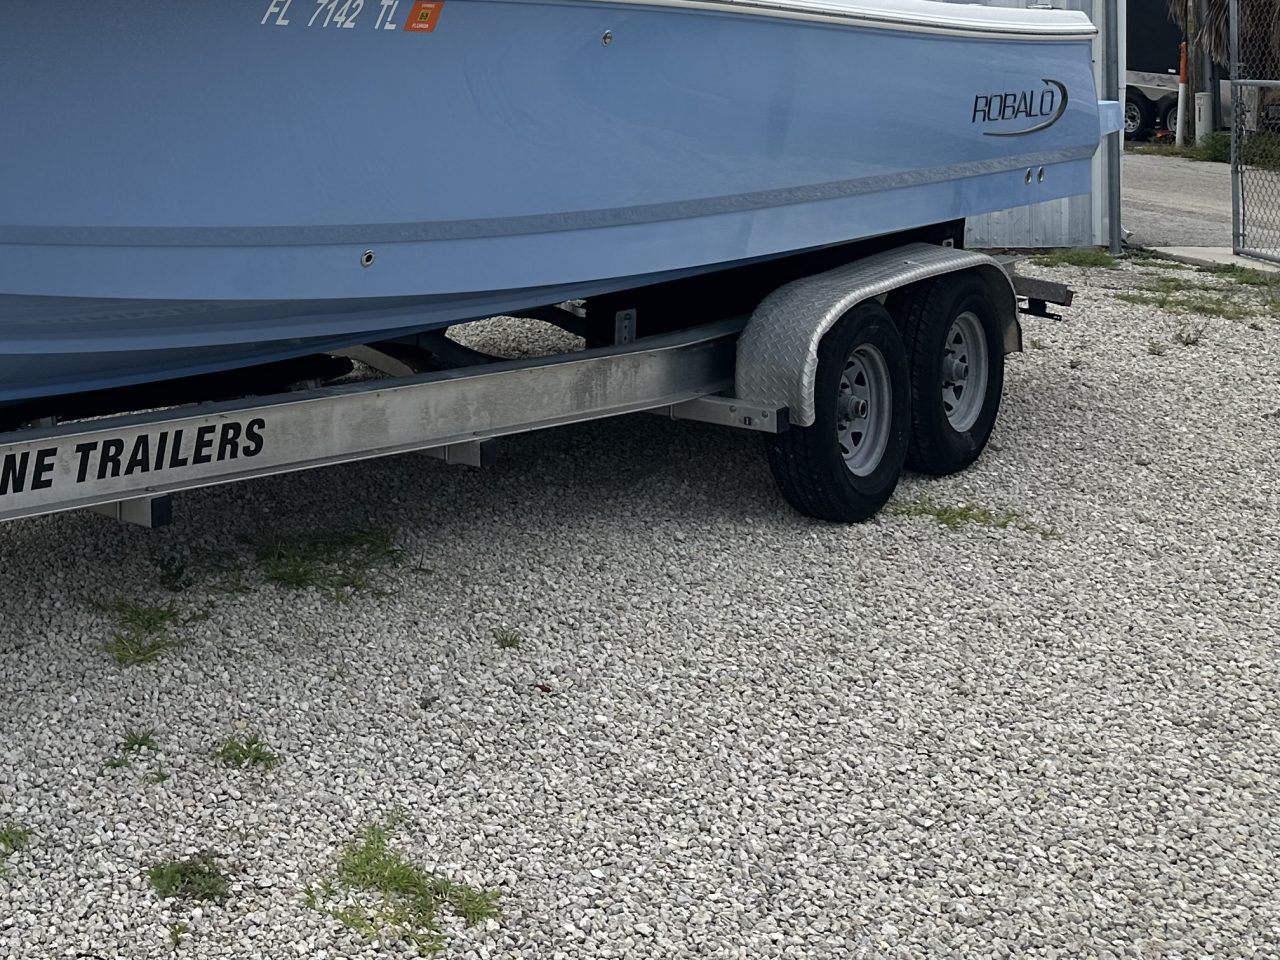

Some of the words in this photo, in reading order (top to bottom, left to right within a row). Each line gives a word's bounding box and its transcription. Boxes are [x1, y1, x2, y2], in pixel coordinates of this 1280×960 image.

[374, 0, 400, 30] TL
[972, 89, 1055, 123] ROBALO
[75, 418, 266, 483] TRAILERS
